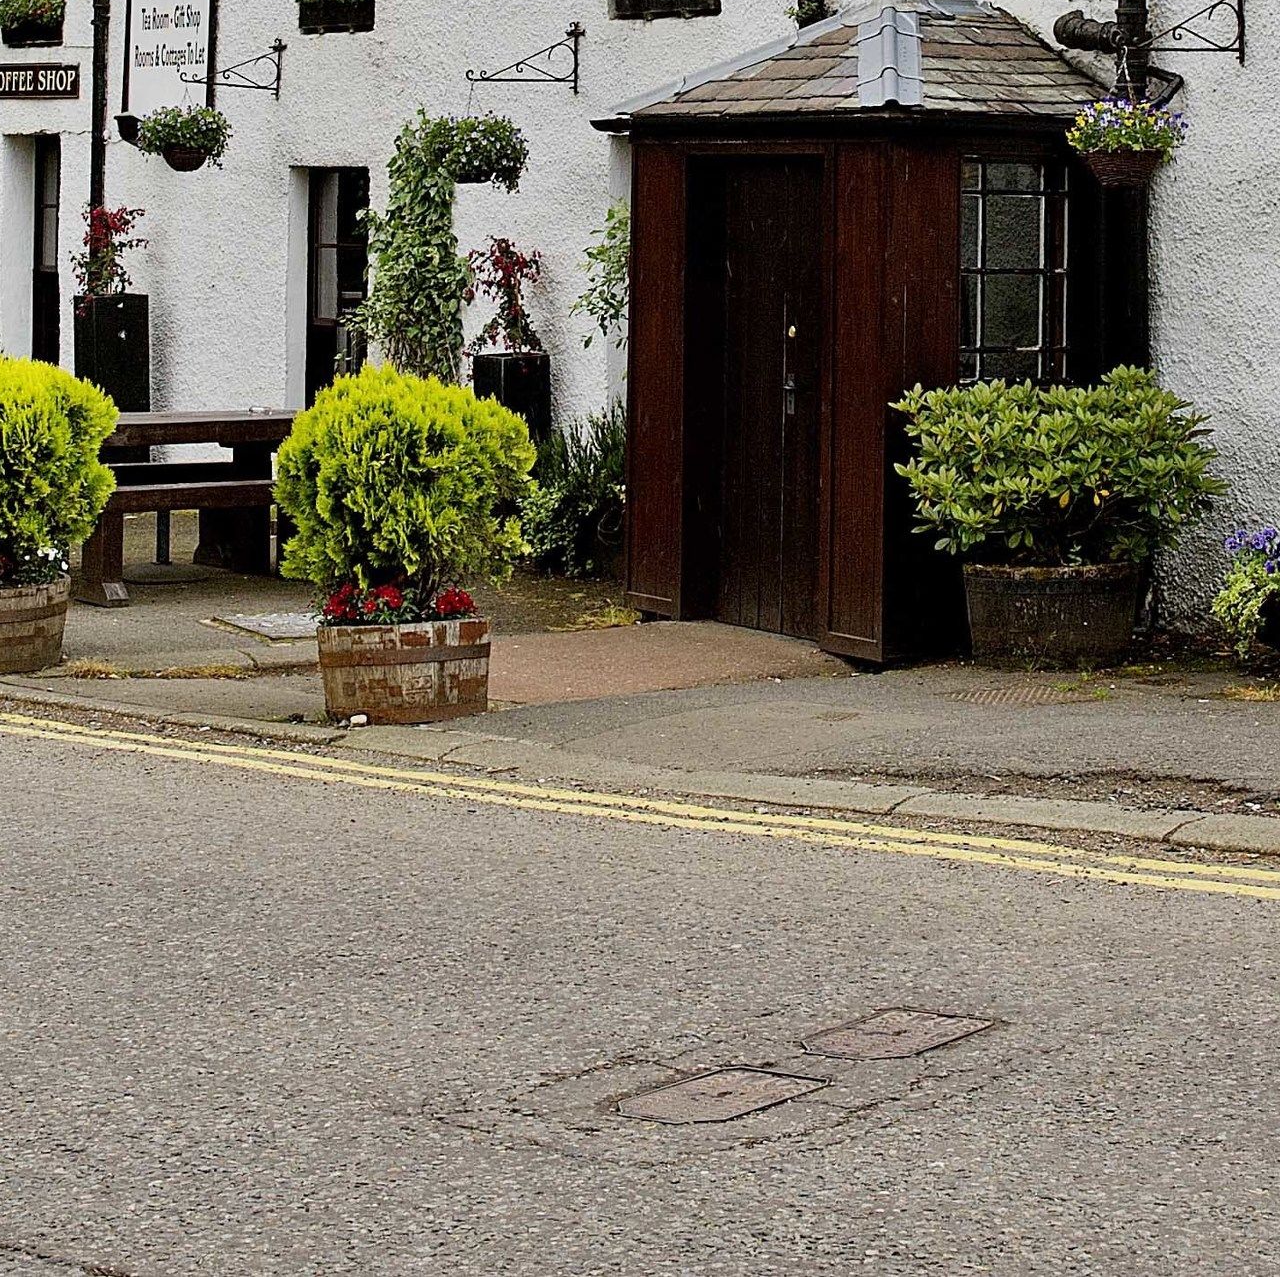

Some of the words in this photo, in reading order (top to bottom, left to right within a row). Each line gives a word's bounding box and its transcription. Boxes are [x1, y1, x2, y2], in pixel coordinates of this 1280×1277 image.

[142, 8, 151, 30] Tea
[152, 7, 169, 30] Room
[174, 5, 185, 28] Gift
[186, 4, 201, 35] Shop
[134, 45, 154, 67] Rooms
[155, 44, 160, 66] &
[161, 43, 186, 72] Cottages
[186, 42, 194, 65] To
[194, 42, 205, 65] Let
[37, 70, 76, 91] SHOP
